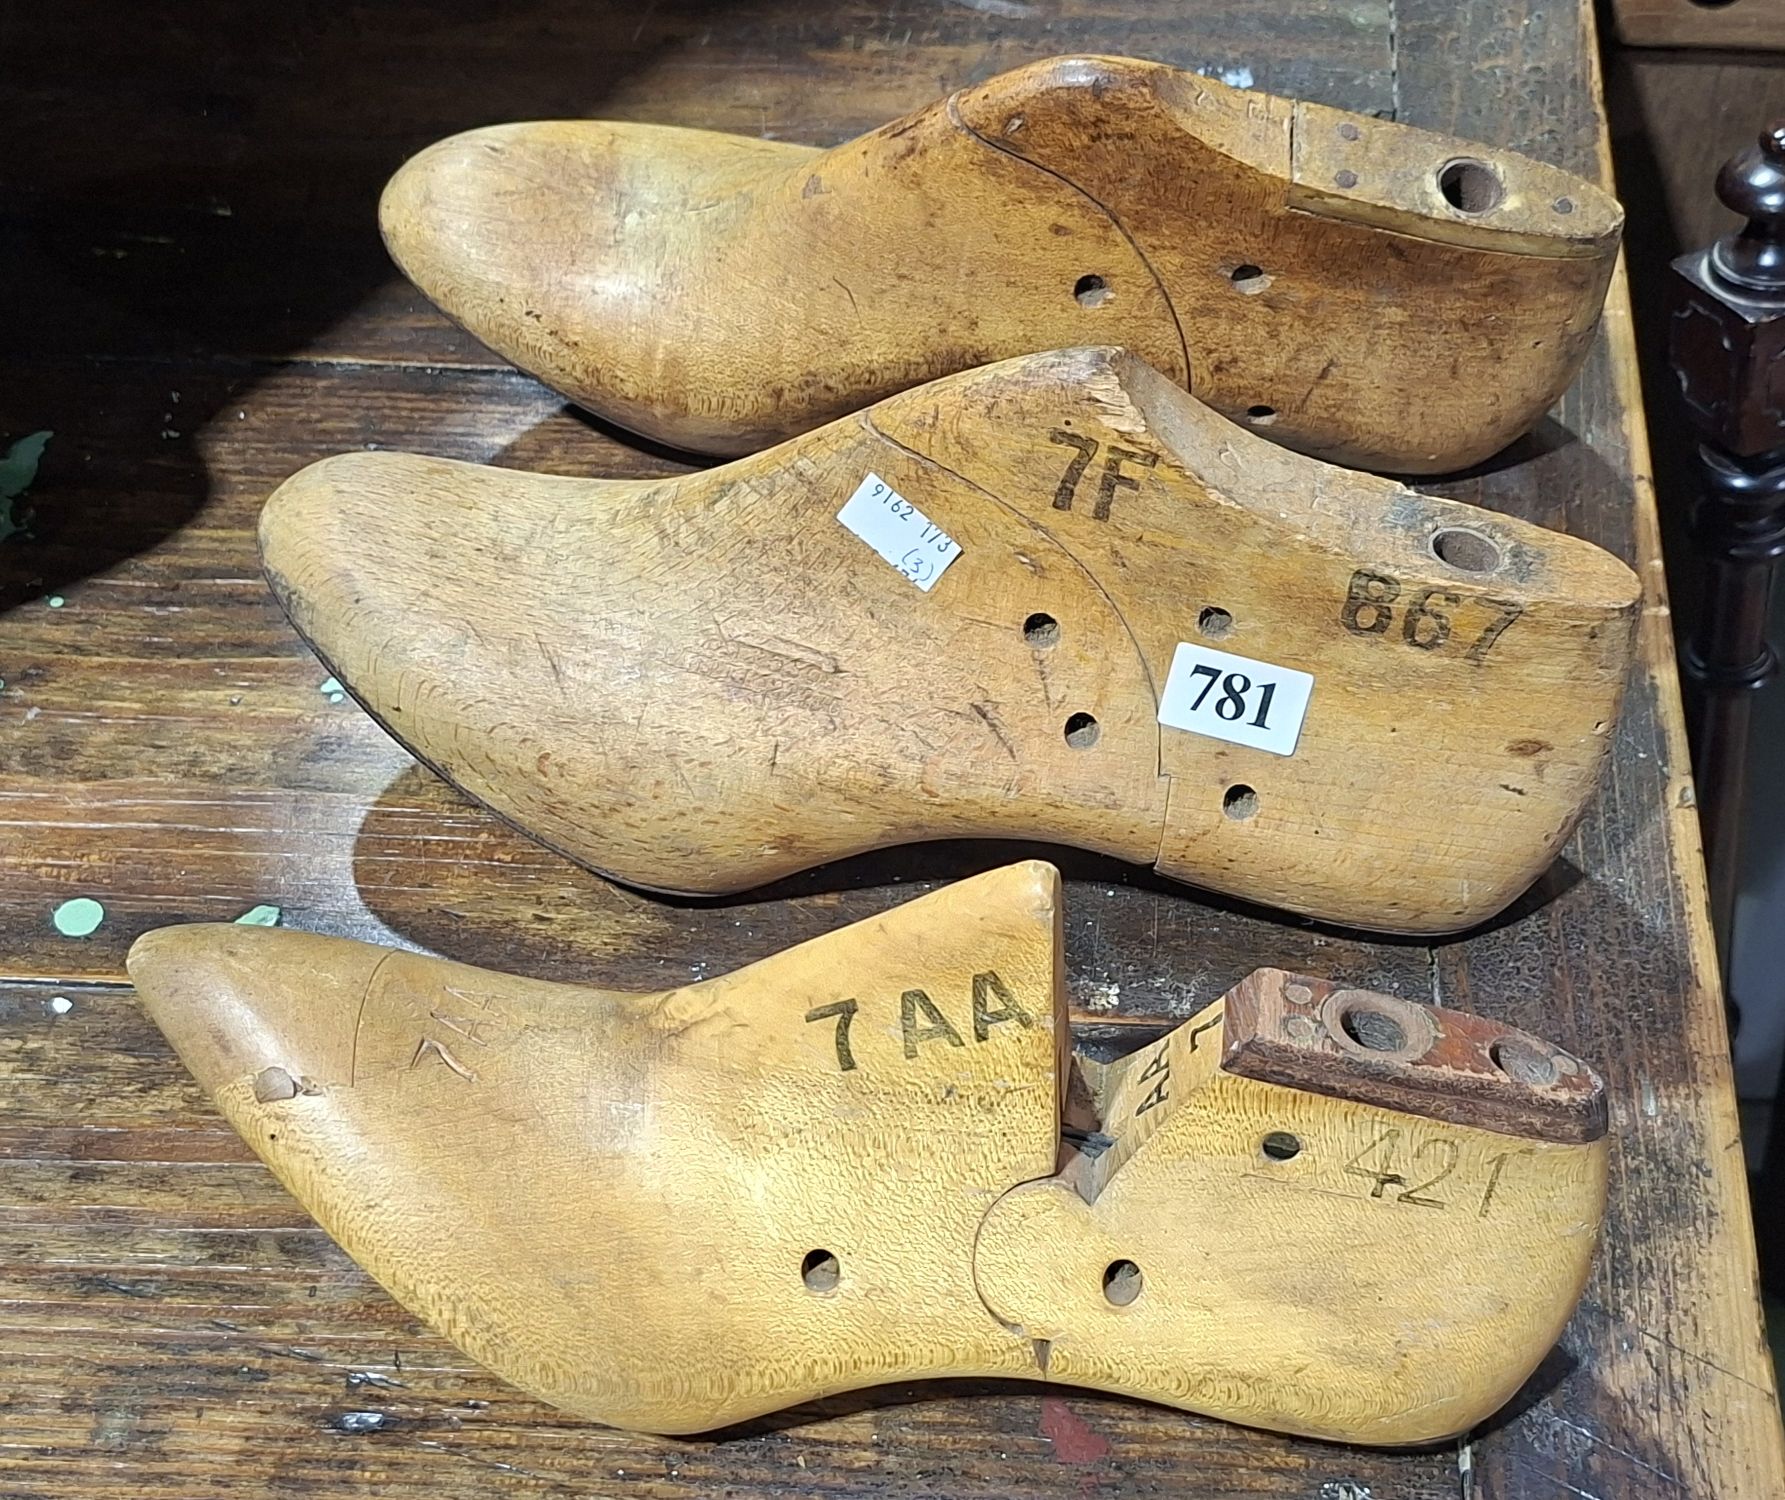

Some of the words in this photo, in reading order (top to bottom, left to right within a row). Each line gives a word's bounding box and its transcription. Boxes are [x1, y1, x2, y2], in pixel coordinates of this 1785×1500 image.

[872, 484, 914, 521] 9162
[1049, 427, 1160, 522] 7F
[1189, 664, 1277, 730] 781
[1343, 1128, 1514, 1218] 421
